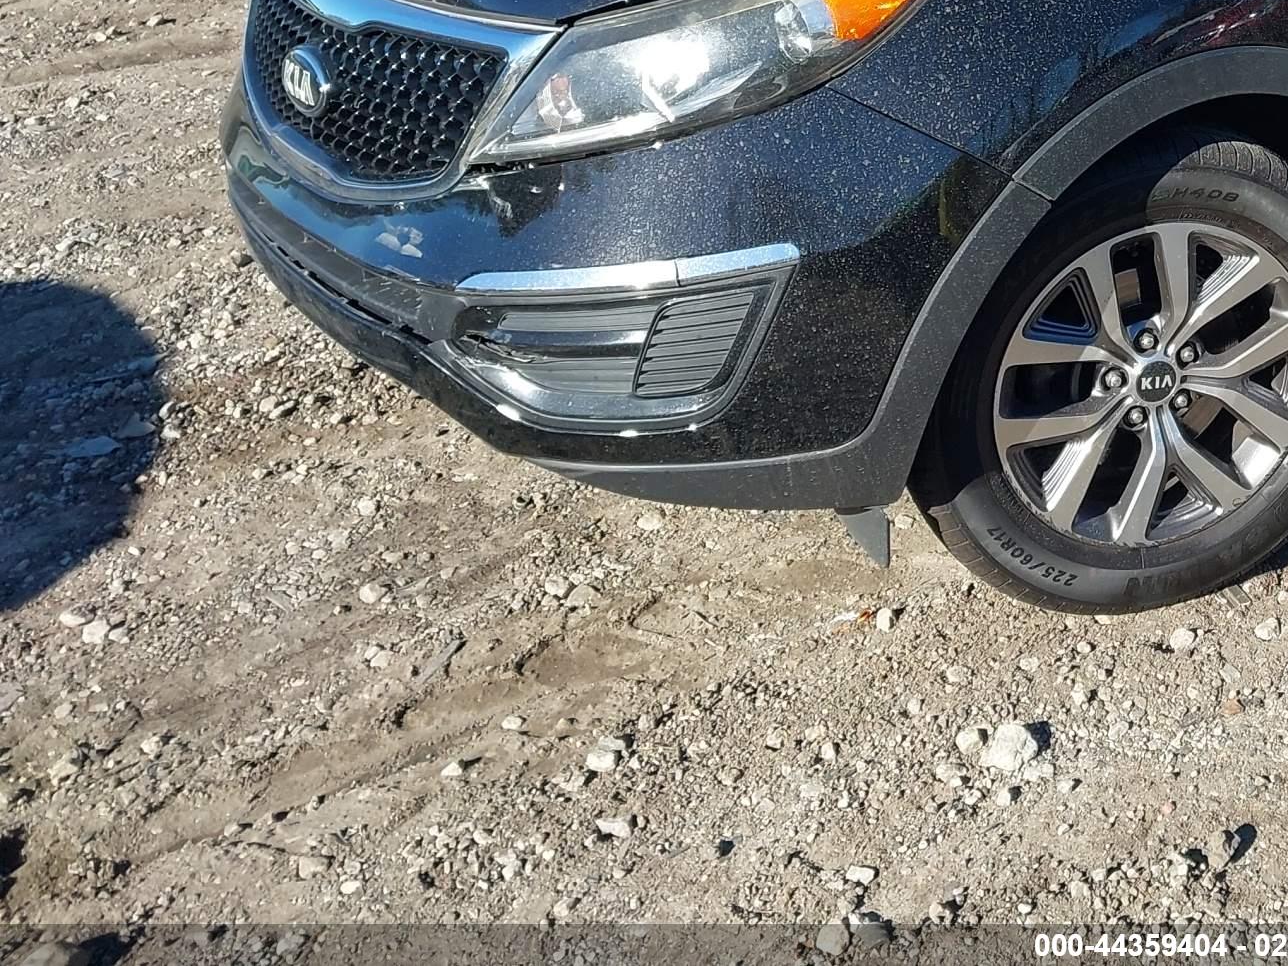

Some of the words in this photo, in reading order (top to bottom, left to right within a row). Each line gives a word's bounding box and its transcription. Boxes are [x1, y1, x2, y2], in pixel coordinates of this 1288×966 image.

[283, 59, 315, 106] KIA
[1140, 374, 1173, 391] KIA
[986, 526, 1079, 587] 225/60R17
